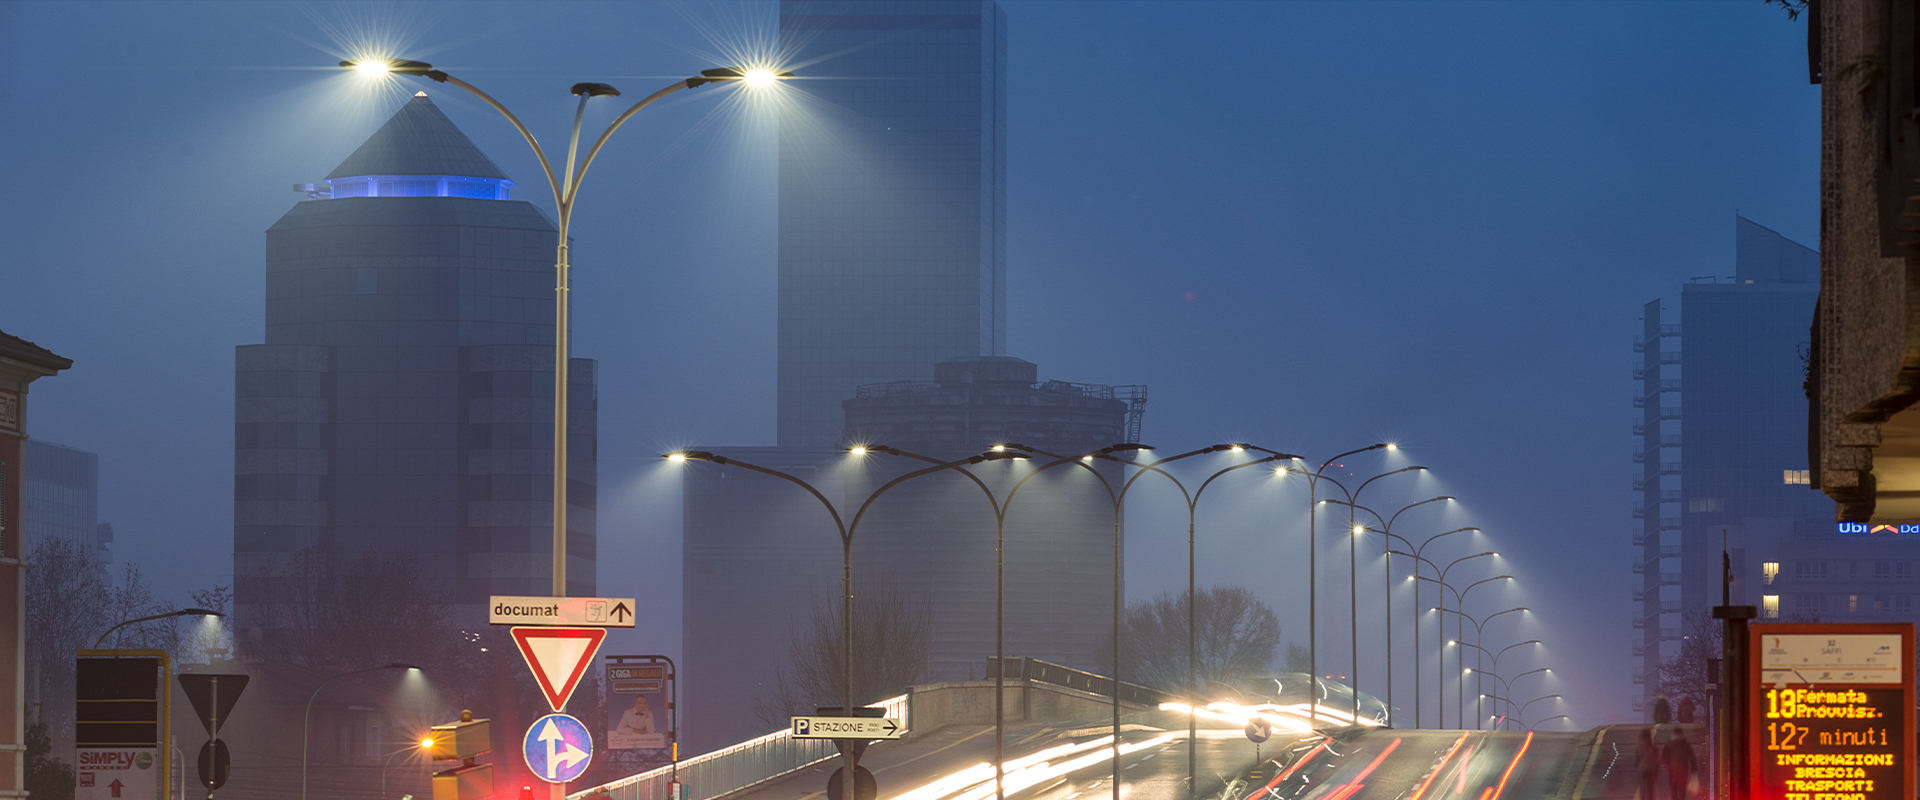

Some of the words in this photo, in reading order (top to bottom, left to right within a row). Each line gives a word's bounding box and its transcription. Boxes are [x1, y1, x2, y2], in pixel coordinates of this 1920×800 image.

[494, 602, 559, 616] documat
[1821, 647, 1842, 655] SAFFI
[610, 669, 616, 678] 2
[616, 669, 631, 678] GIGA
[631, 669, 638, 678] IN
[638, 668, 662, 678] REGALO
[1796, 689, 1868, 704] Fermata
[813, 722, 864, 732] STAZIONE
[1767, 722, 1796, 750] 12
[1797, 727, 1809, 745] 7
[1820, 727, 1888, 745] minuti
[1777, 753, 1894, 766] INFORMAZIONI
[1795, 767, 1866, 779] BRESCIA
[1785, 780, 1874, 792] TRASPORTI
